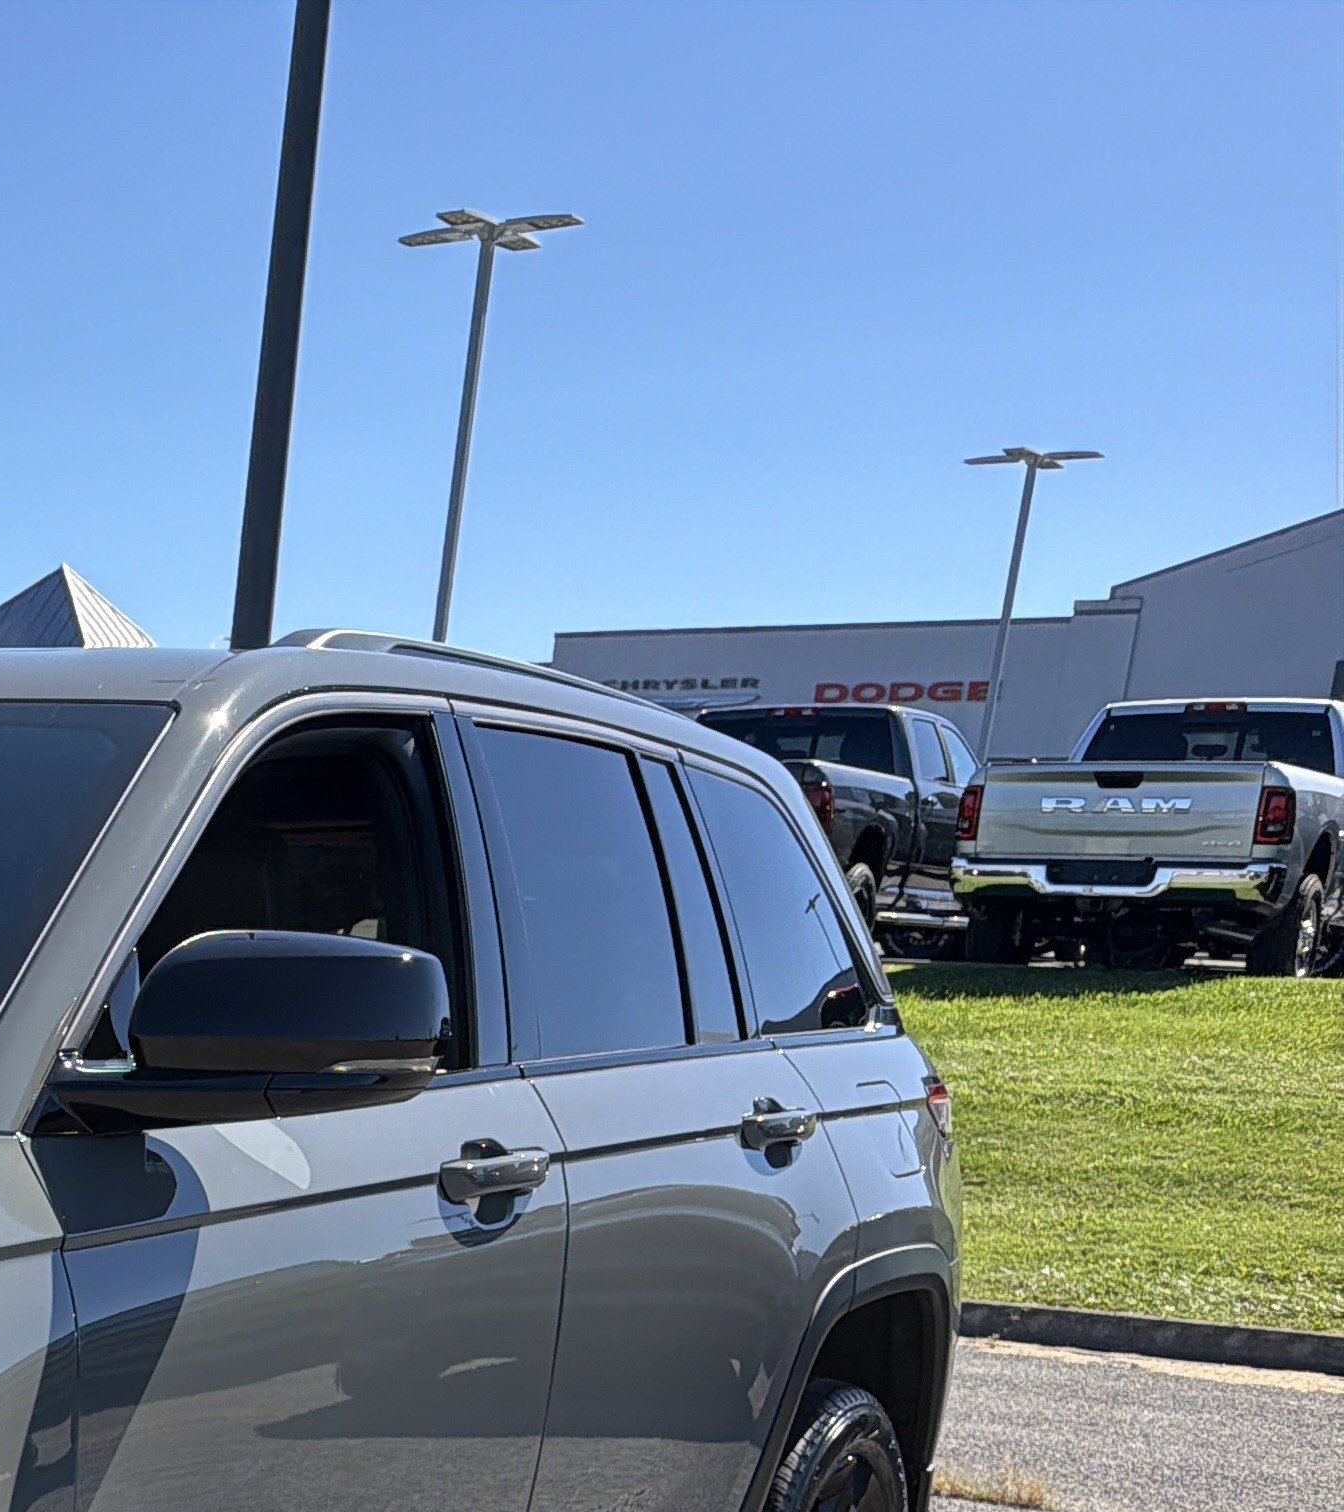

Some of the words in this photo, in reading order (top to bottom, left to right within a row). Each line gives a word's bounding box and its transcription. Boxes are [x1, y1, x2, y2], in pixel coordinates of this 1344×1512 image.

[602, 677, 761, 690] CHRYSLER
[814, 681, 990, 703] DODGE
[1041, 797, 1193, 815] RAM
